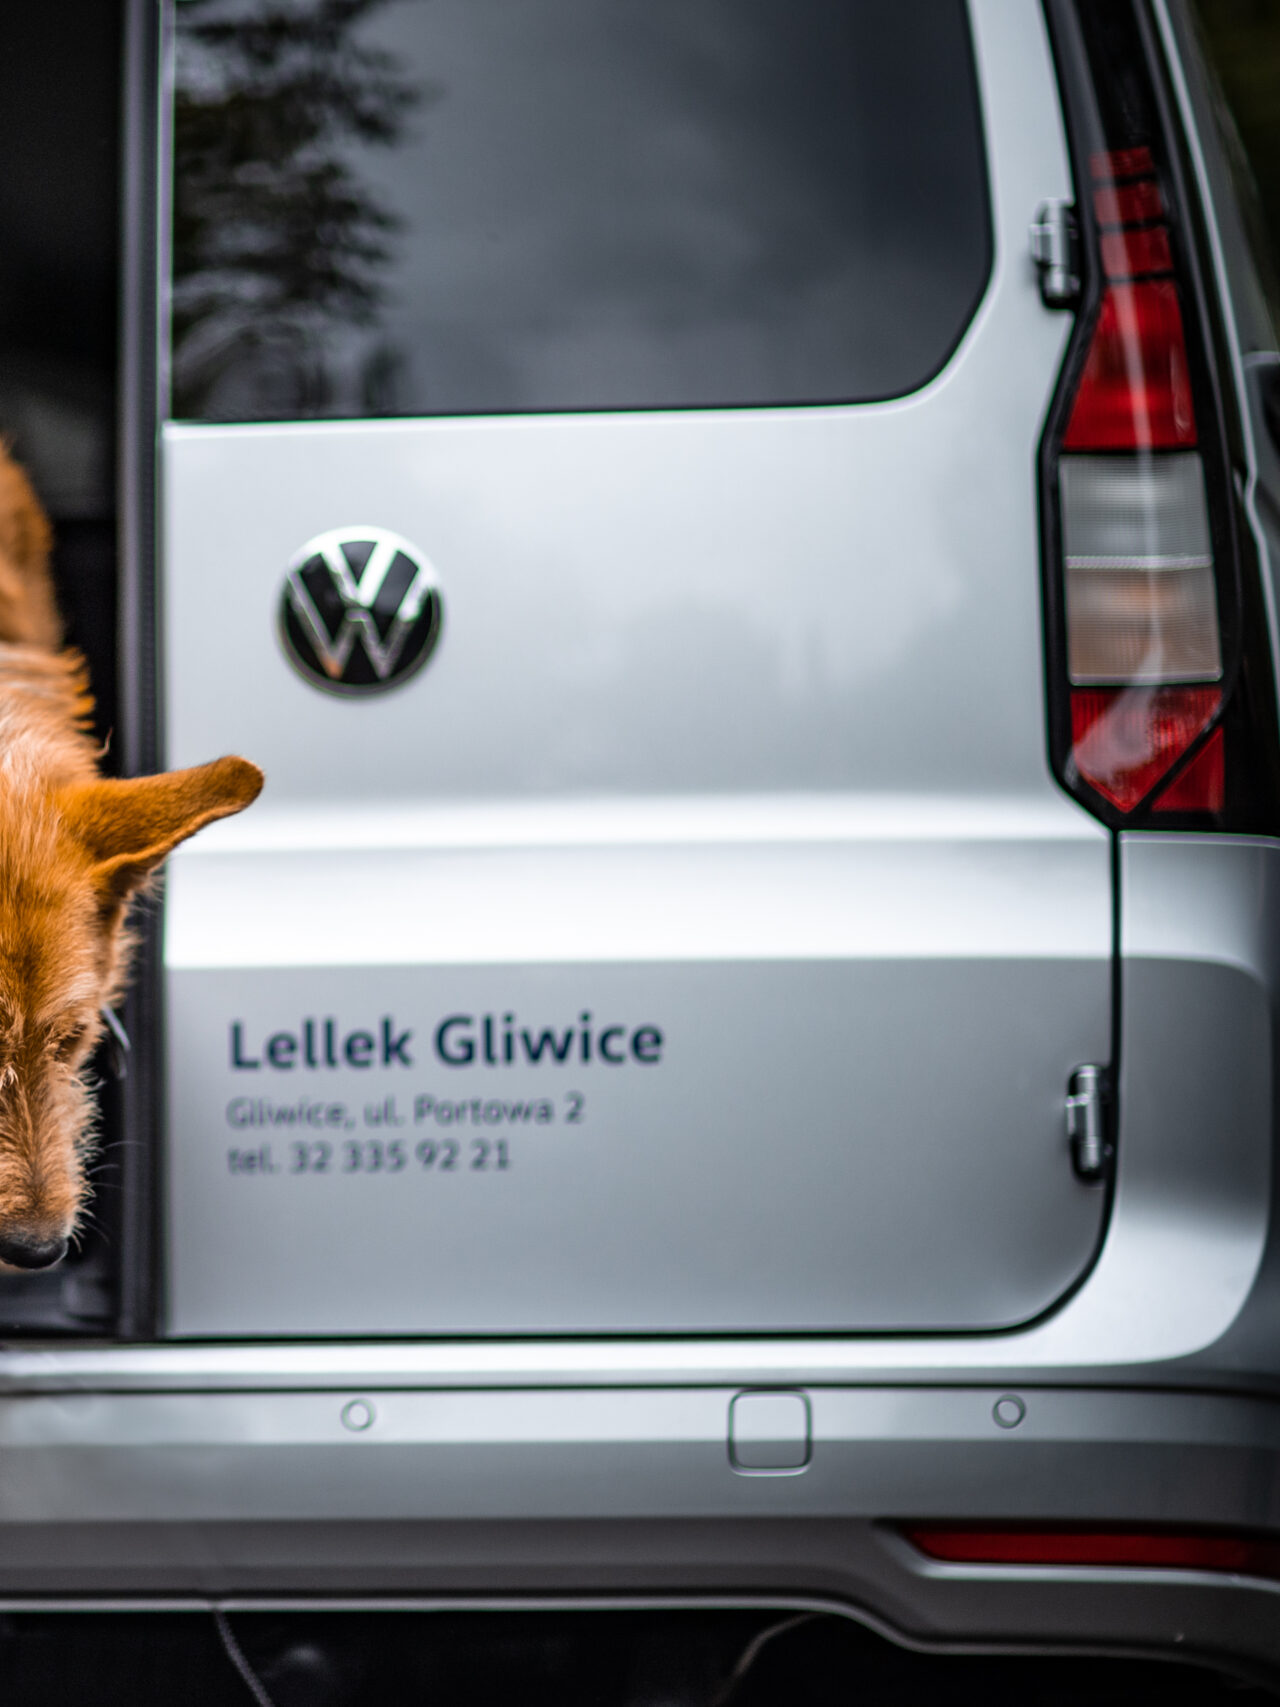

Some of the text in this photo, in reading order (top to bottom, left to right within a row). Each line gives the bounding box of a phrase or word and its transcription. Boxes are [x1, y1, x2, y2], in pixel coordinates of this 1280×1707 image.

[230, 1010, 664, 1069] Lellek Gliwice
[226, 1090, 586, 1132] Gliwice, ul. Portowa 2
[228, 1138, 511, 1175] tel. 32 335 92 21
